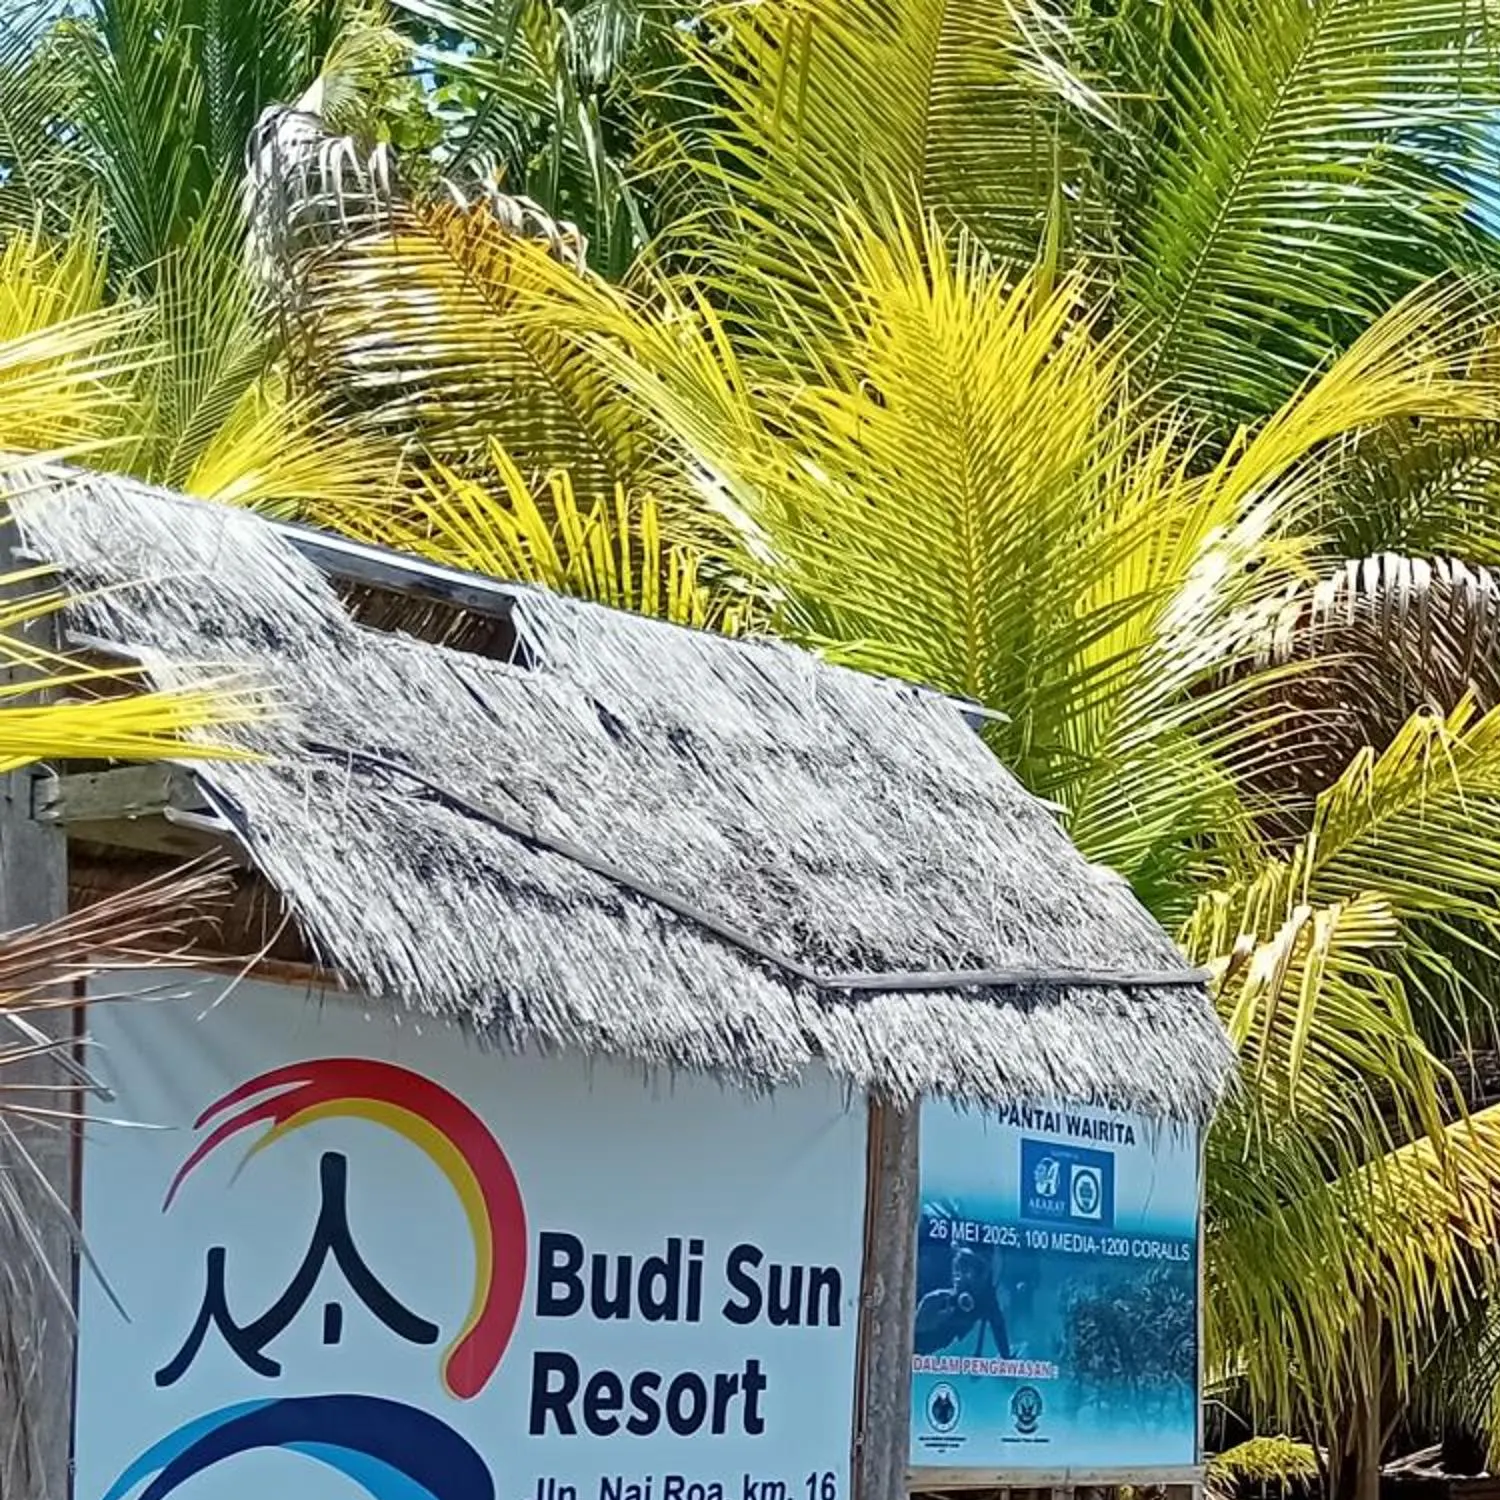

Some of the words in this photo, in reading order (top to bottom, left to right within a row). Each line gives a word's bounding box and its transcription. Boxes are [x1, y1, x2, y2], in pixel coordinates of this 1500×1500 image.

[998, 1103, 1061, 1133] PANTAI
[1066, 1115, 1136, 1146] WAIRITA
[929, 1218, 948, 1239] 26
[951, 1220, 979, 1242] MEI
[1025, 1230, 1049, 1249] 100
[1131, 1239, 1190, 1261] CORALLS
[535, 1231, 705, 1322] Budi
[721, 1243, 842, 1327] Sun
[912, 1355, 960, 1374] DALAM
[528, 1350, 767, 1436] Resort
